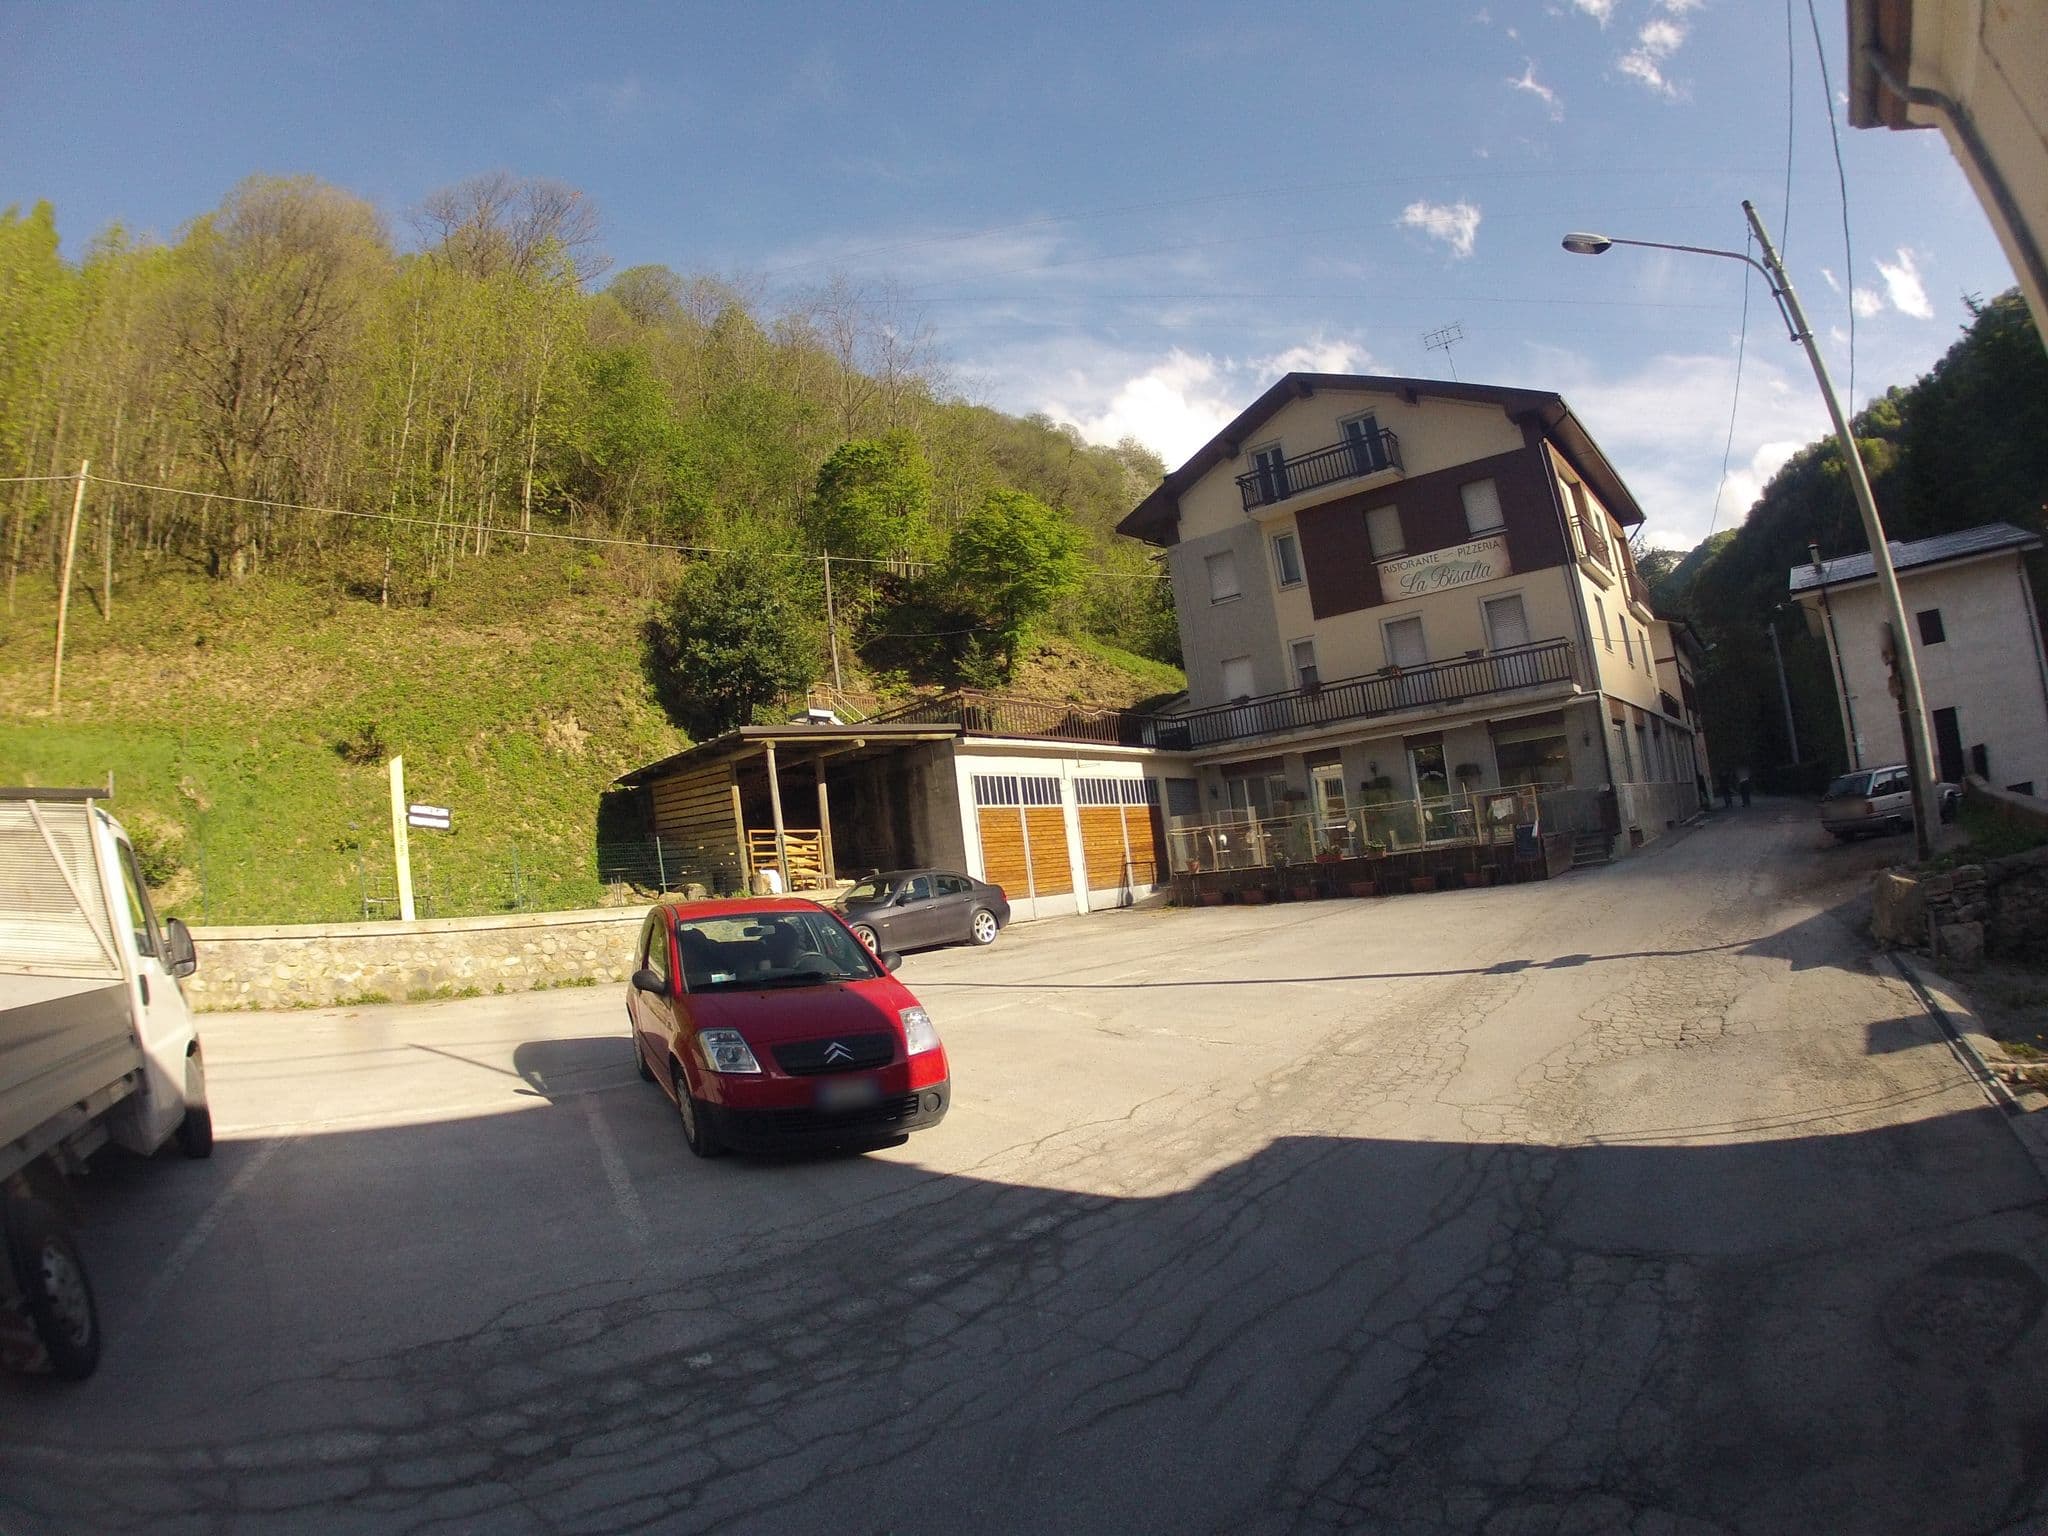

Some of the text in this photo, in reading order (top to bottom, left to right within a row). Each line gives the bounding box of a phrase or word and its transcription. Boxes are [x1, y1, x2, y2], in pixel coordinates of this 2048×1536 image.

[1383, 540, 1501, 575] RISTORANTE PIZZERIA
[1400, 560, 1493, 595] La Bisalta
